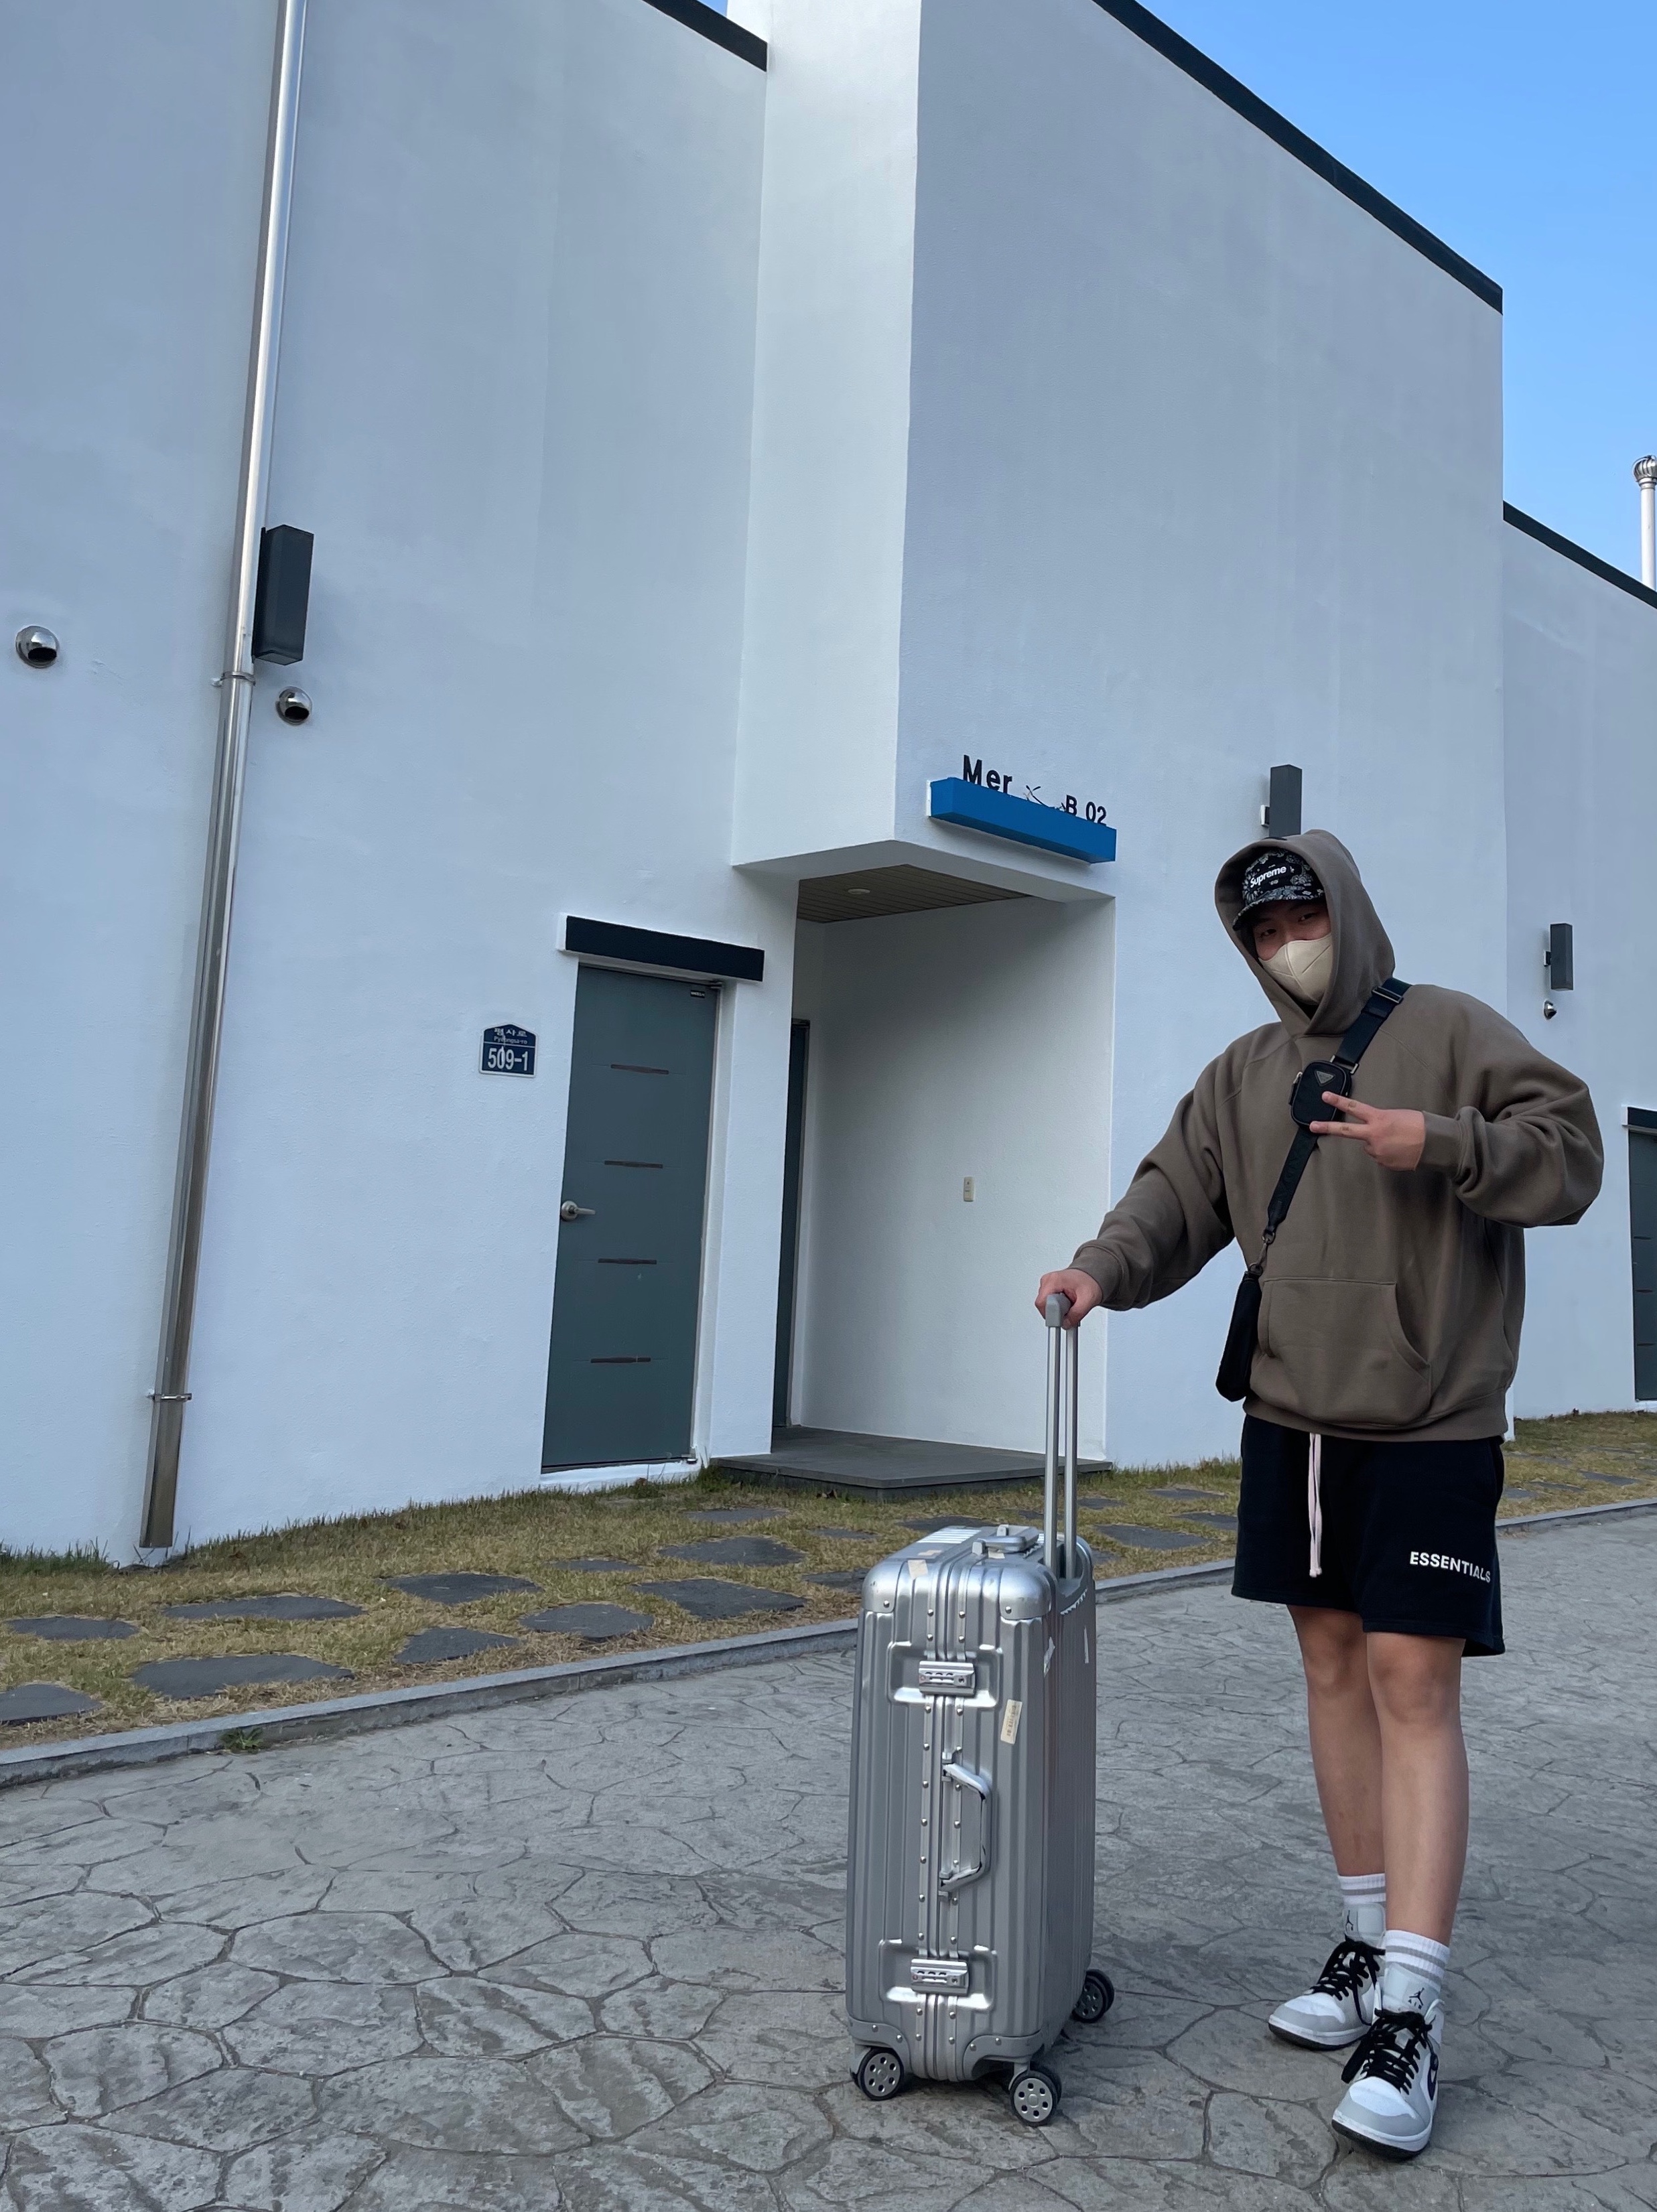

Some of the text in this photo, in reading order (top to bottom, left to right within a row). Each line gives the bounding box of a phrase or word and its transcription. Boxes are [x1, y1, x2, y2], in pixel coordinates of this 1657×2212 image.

[963, 754, 1012, 794] Mer
[1085, 801, 1107, 826] 02
[1250, 866, 1286, 888] Supreme
[487, 1046, 528, 1071] 509-1
[1409, 1551, 1492, 1584] ESSENTIALS
